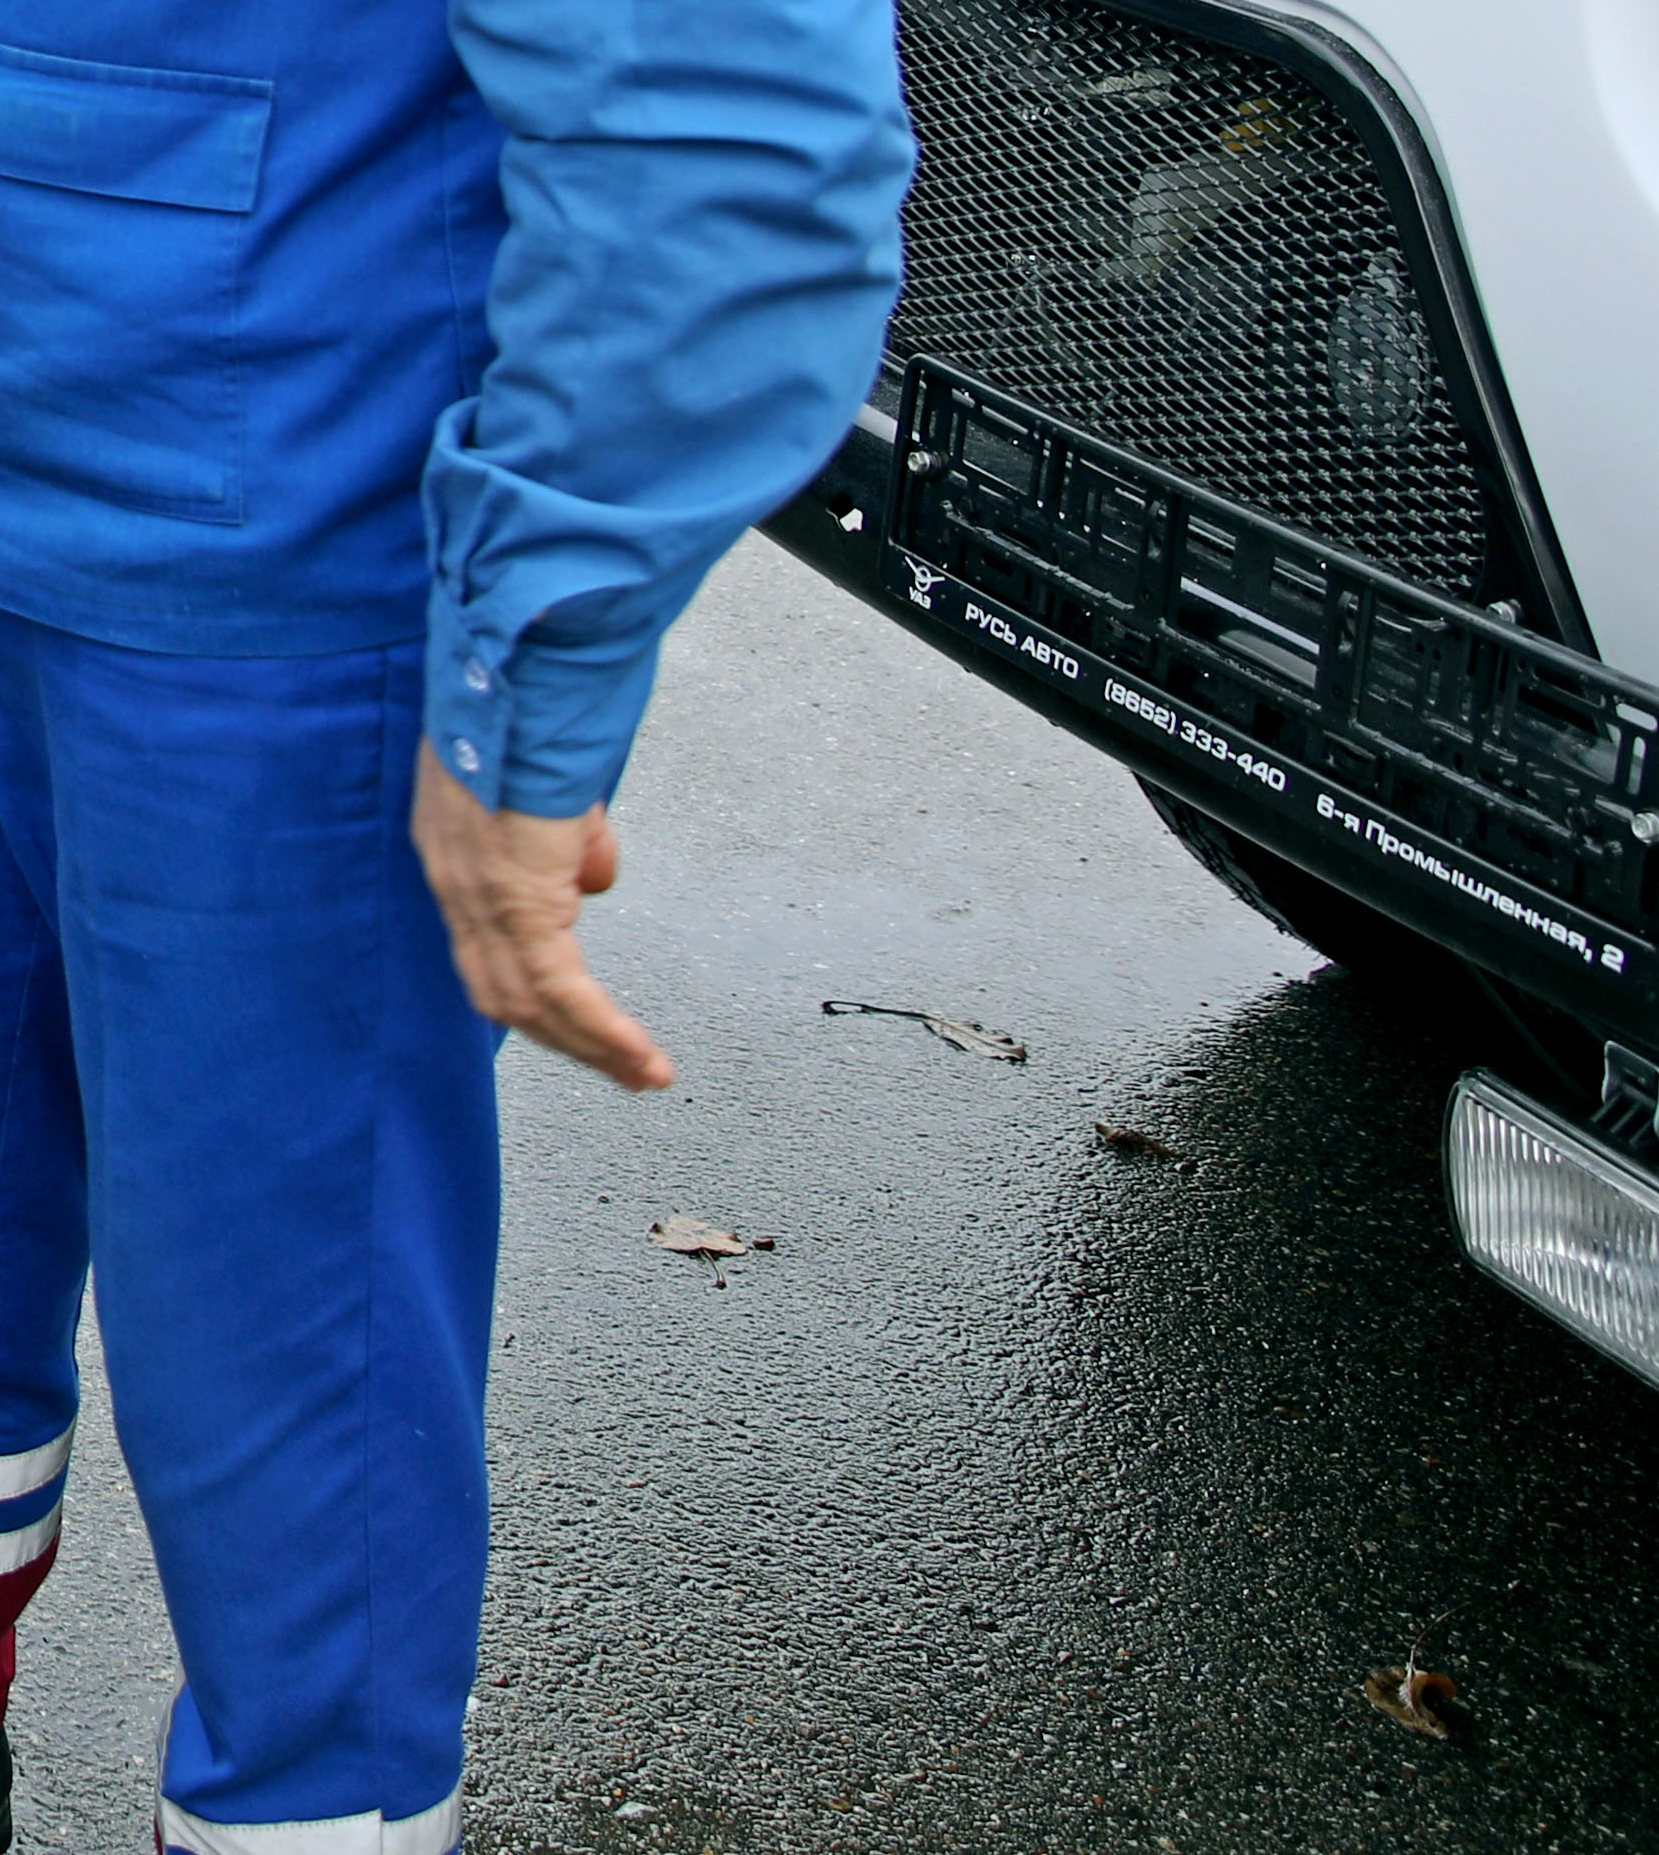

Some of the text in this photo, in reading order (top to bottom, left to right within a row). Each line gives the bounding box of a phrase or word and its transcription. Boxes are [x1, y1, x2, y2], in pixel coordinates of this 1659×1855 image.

[909, 585, 932, 610] УАЗ
[965, 602, 1625, 974] РУСЬ АВТО (8652) 333-440 6-я Промышленная, 2
